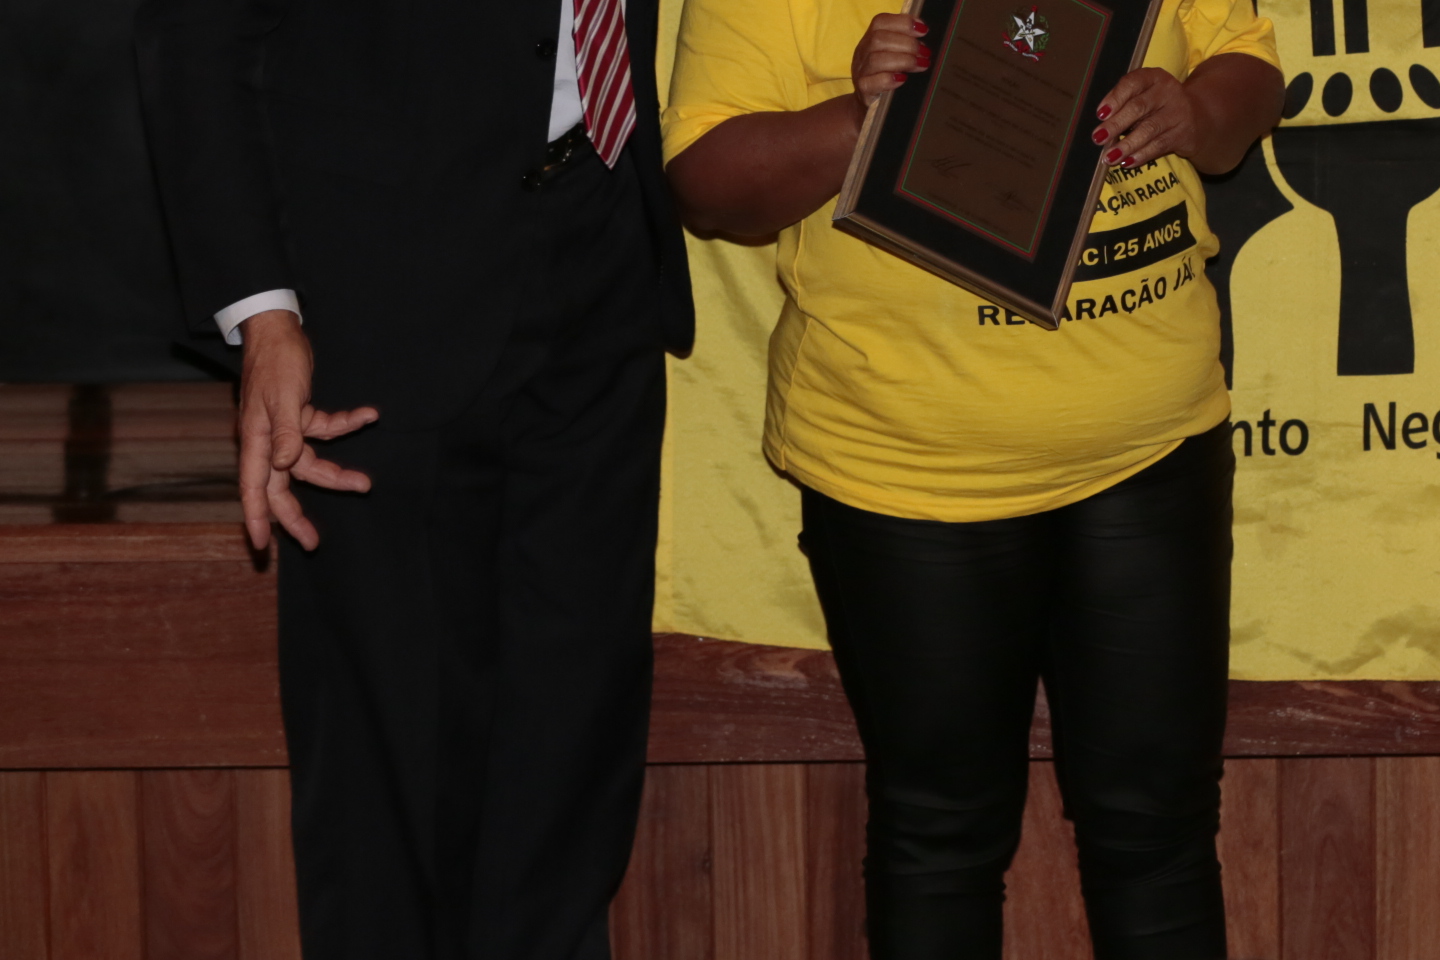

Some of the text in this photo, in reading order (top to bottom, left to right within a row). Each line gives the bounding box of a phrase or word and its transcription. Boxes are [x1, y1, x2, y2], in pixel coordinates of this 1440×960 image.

[1134, 172, 1180, 202] RACIA
[1113, 238, 1139, 261] 25
[1143, 219, 1182, 252] ANOS
[977, 277, 1167, 326] REARAÇÃO
[1229, 407, 1310, 457] nto
